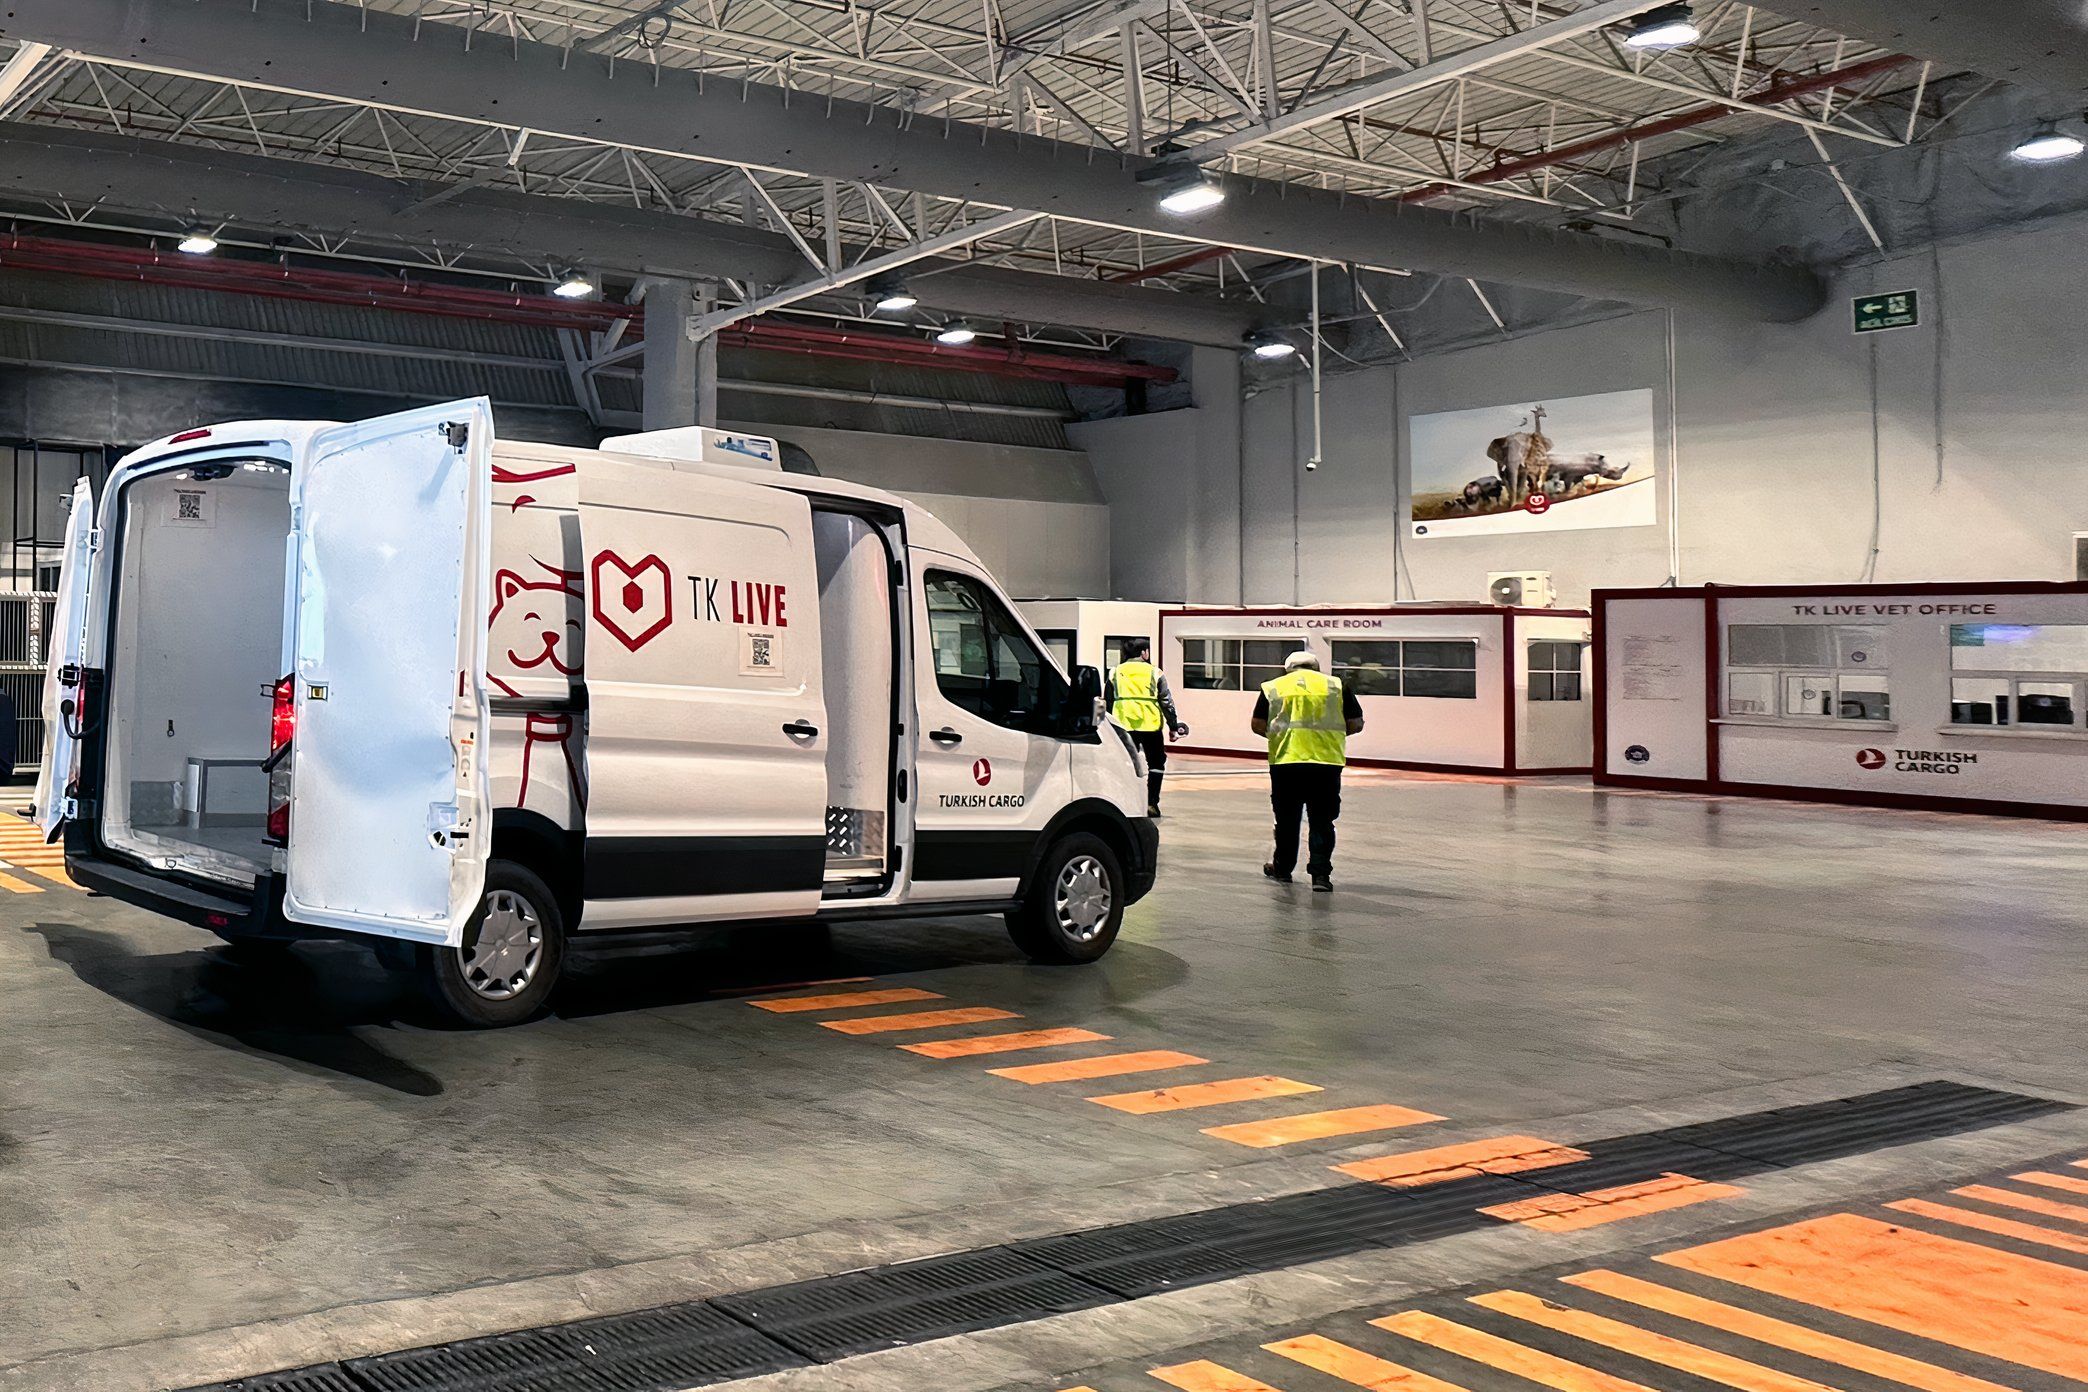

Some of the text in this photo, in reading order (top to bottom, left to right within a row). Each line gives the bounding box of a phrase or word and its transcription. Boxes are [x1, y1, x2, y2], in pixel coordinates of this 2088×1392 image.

[687, 575, 788, 627] TK LIVE
[1792, 603, 1997, 616] TK LIVE VET OFFICE
[1257, 619, 1383, 629] ANIMAL CARE ROOM
[1895, 749, 1978, 764] TURKISH
[1895, 761, 1960, 775] CARGO
[939, 794, 1026, 808] TURKISH CARGO
